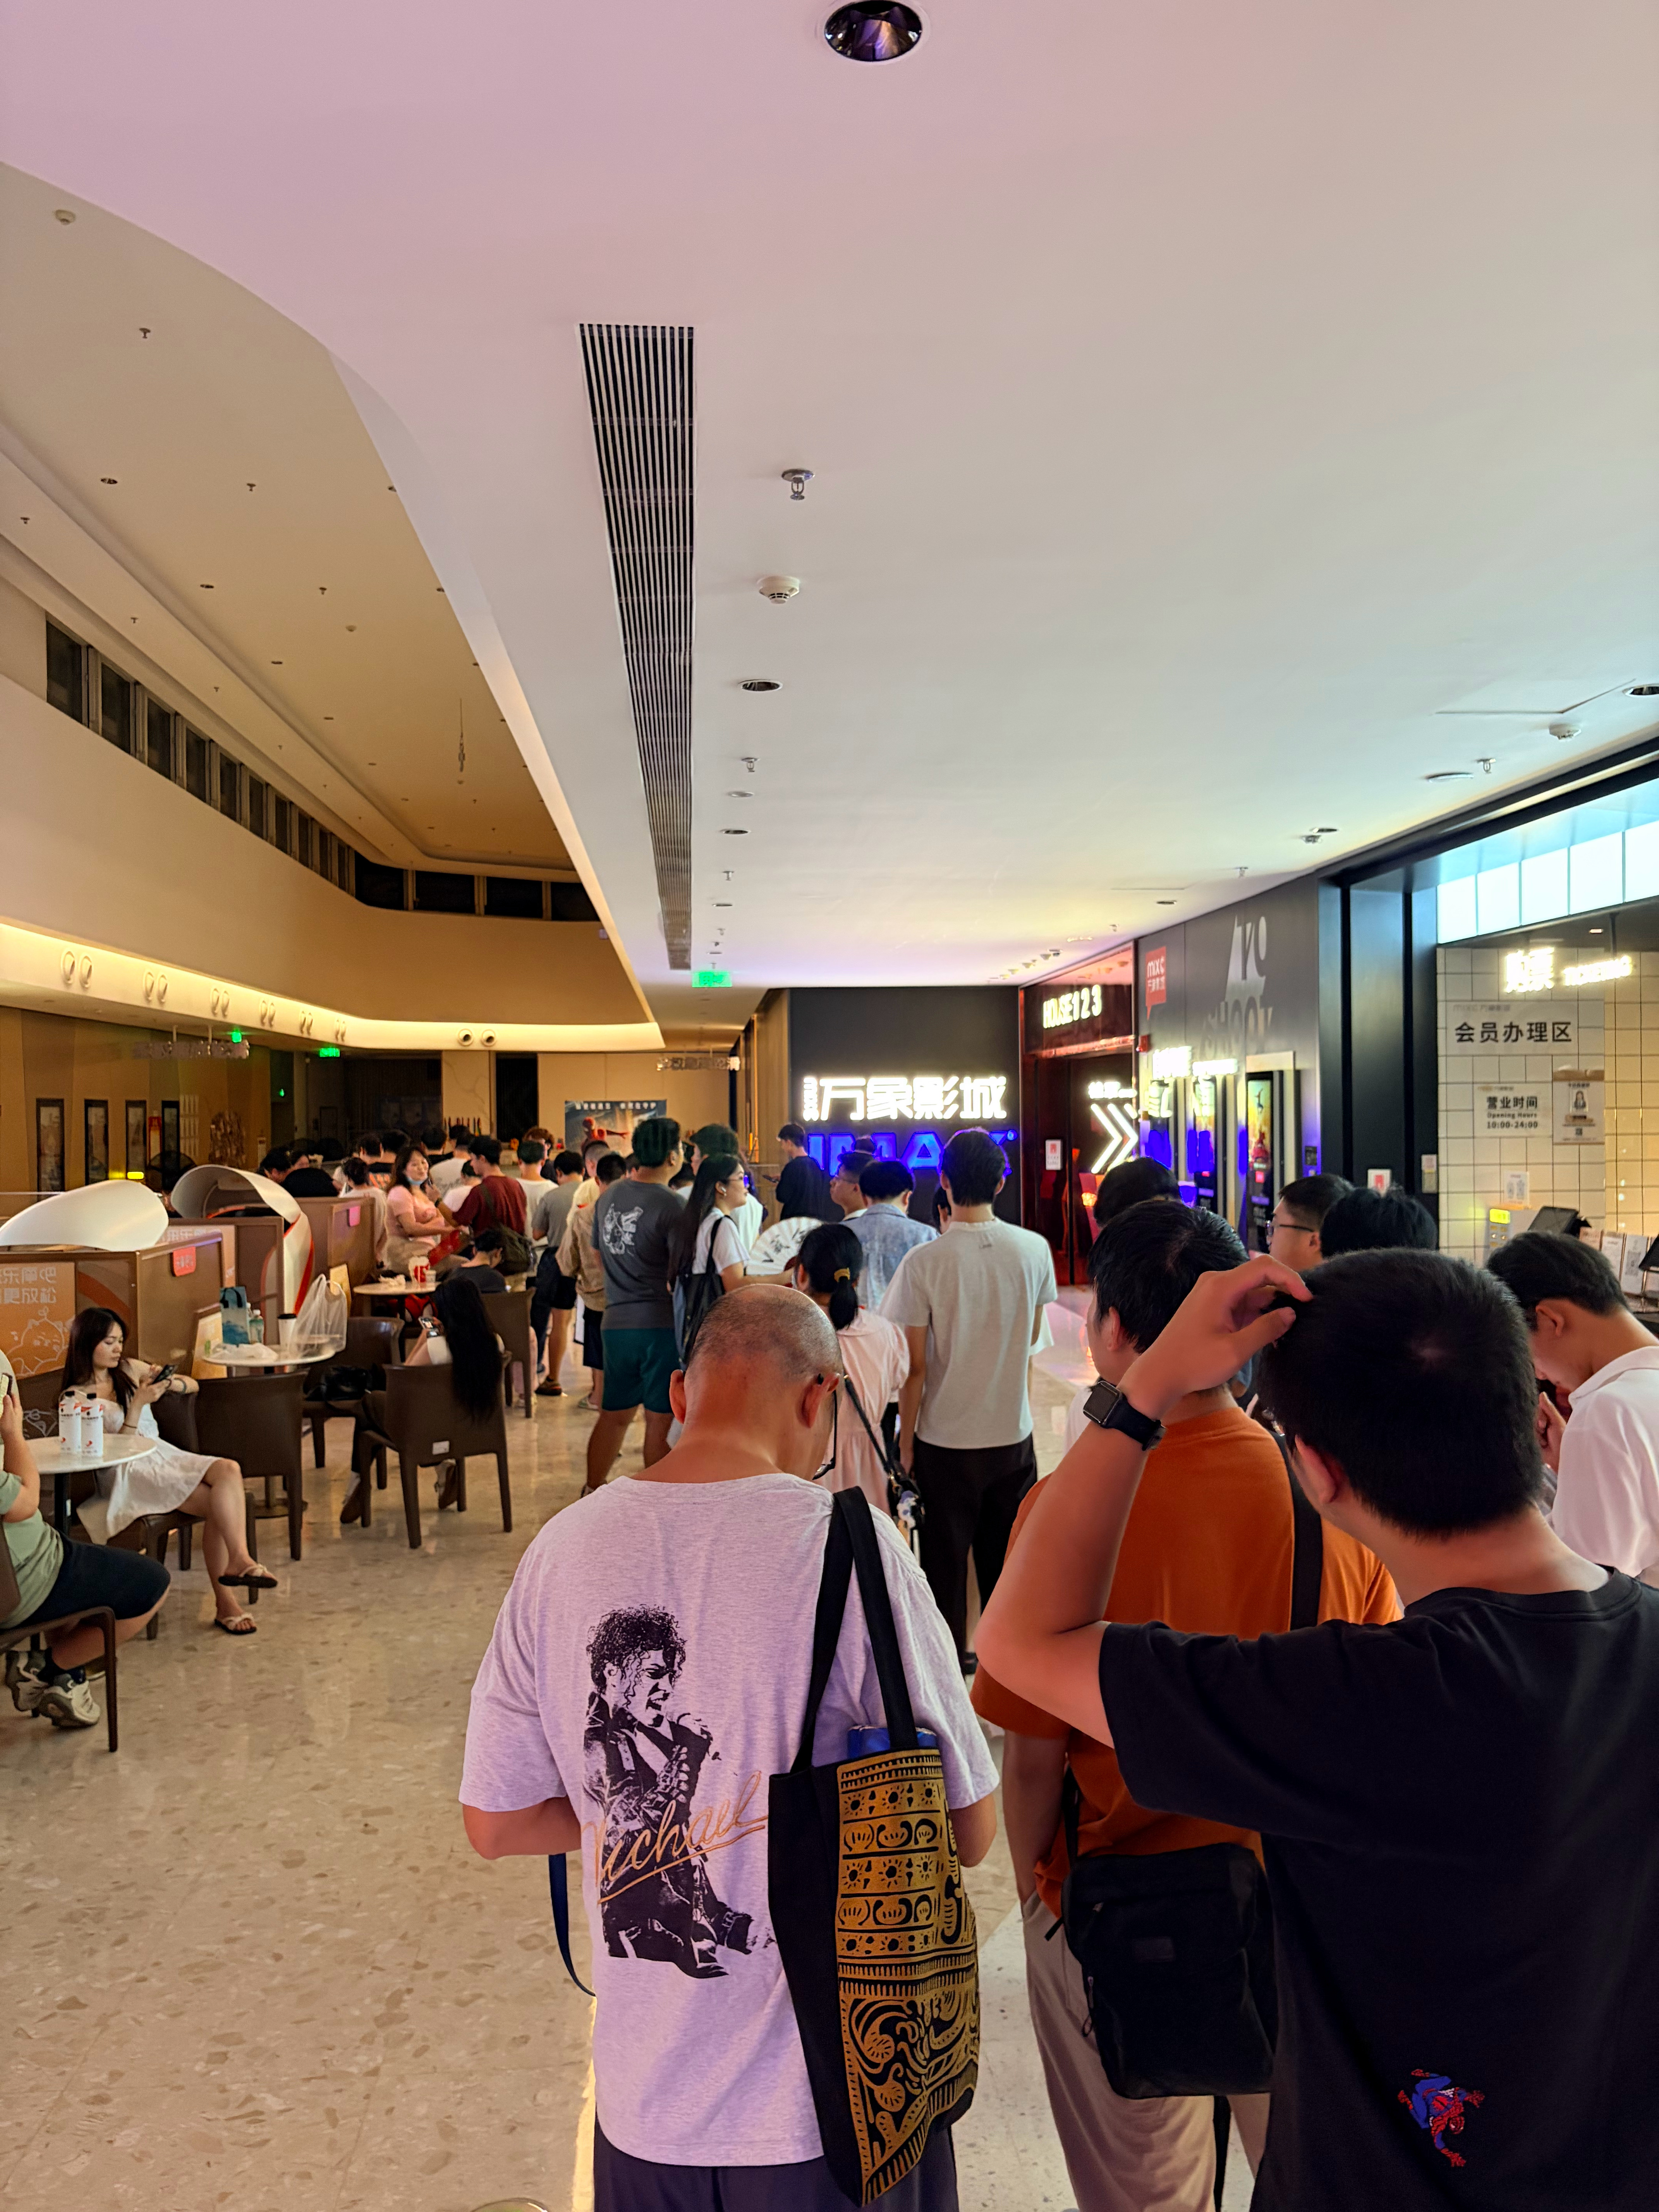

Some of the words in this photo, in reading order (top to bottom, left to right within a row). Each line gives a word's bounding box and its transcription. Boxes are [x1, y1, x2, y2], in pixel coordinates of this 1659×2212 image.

[1455, 1021, 1572, 1043] 会员办理区
[819, 1077, 1007, 1120] 万象影城
[1487, 1096, 1537, 1109] 营业时间
[0, 1267, 57, 1284] 乐摩吧
[0, 1287, 57, 1304] 更放松
